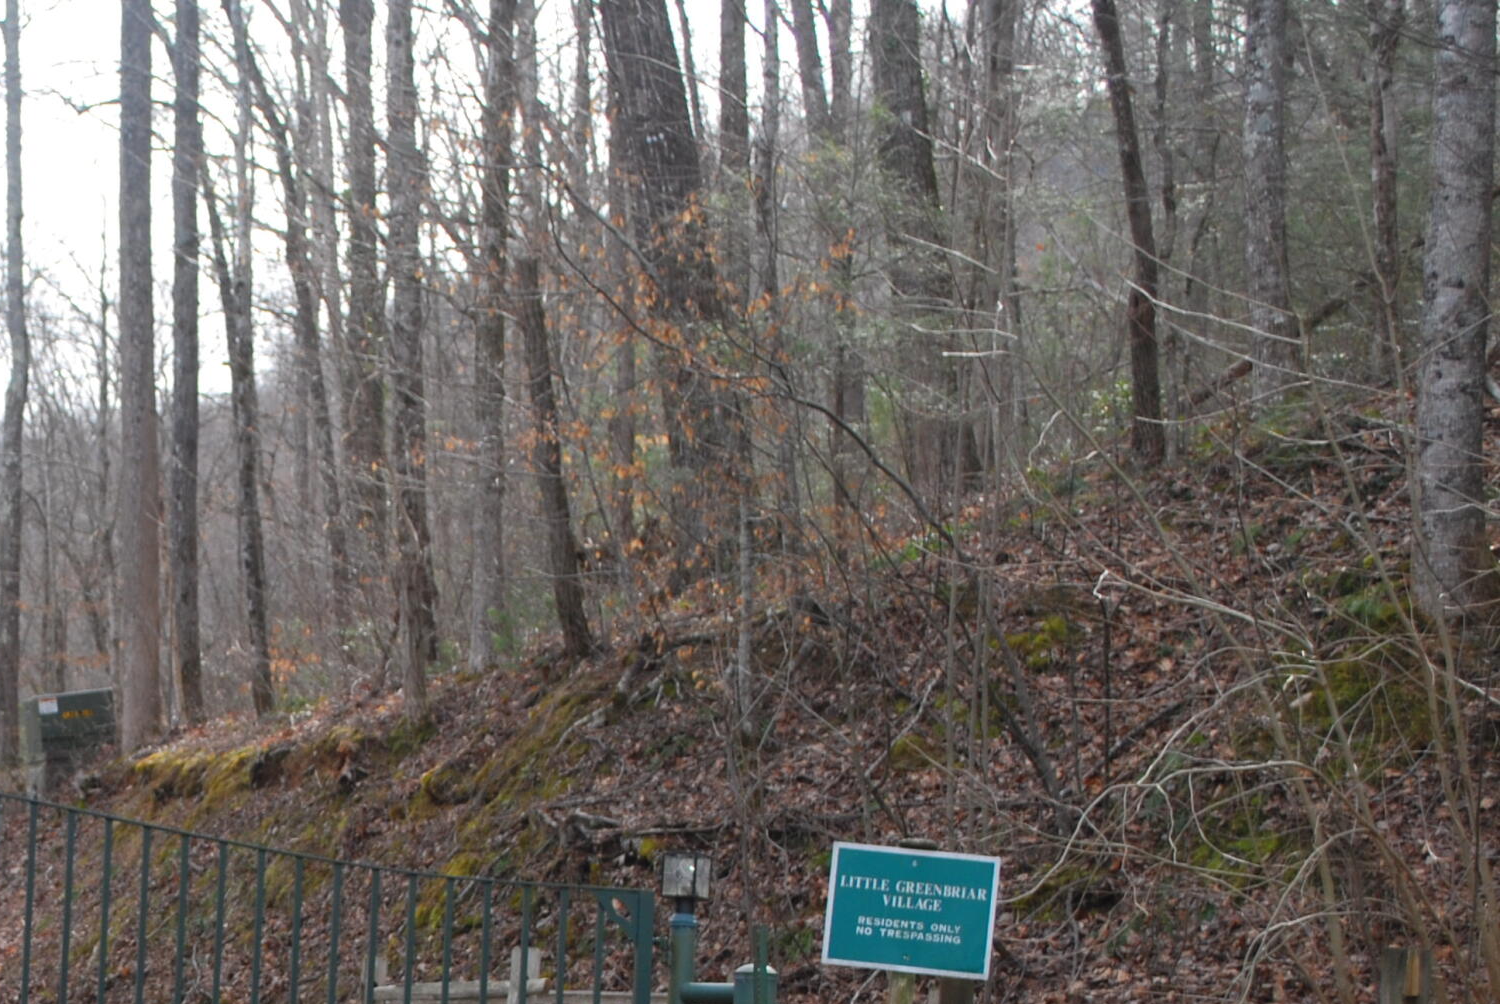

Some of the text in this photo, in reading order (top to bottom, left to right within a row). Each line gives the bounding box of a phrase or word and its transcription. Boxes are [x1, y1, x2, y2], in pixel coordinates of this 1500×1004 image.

[840, 875, 988, 901] LITTLE GREENBRIAR
[882, 894, 942, 912] VILLAGE
[858, 916, 961, 934] RESIDENTS ONLY
[856, 926, 961, 945] NO TRESPASSING
